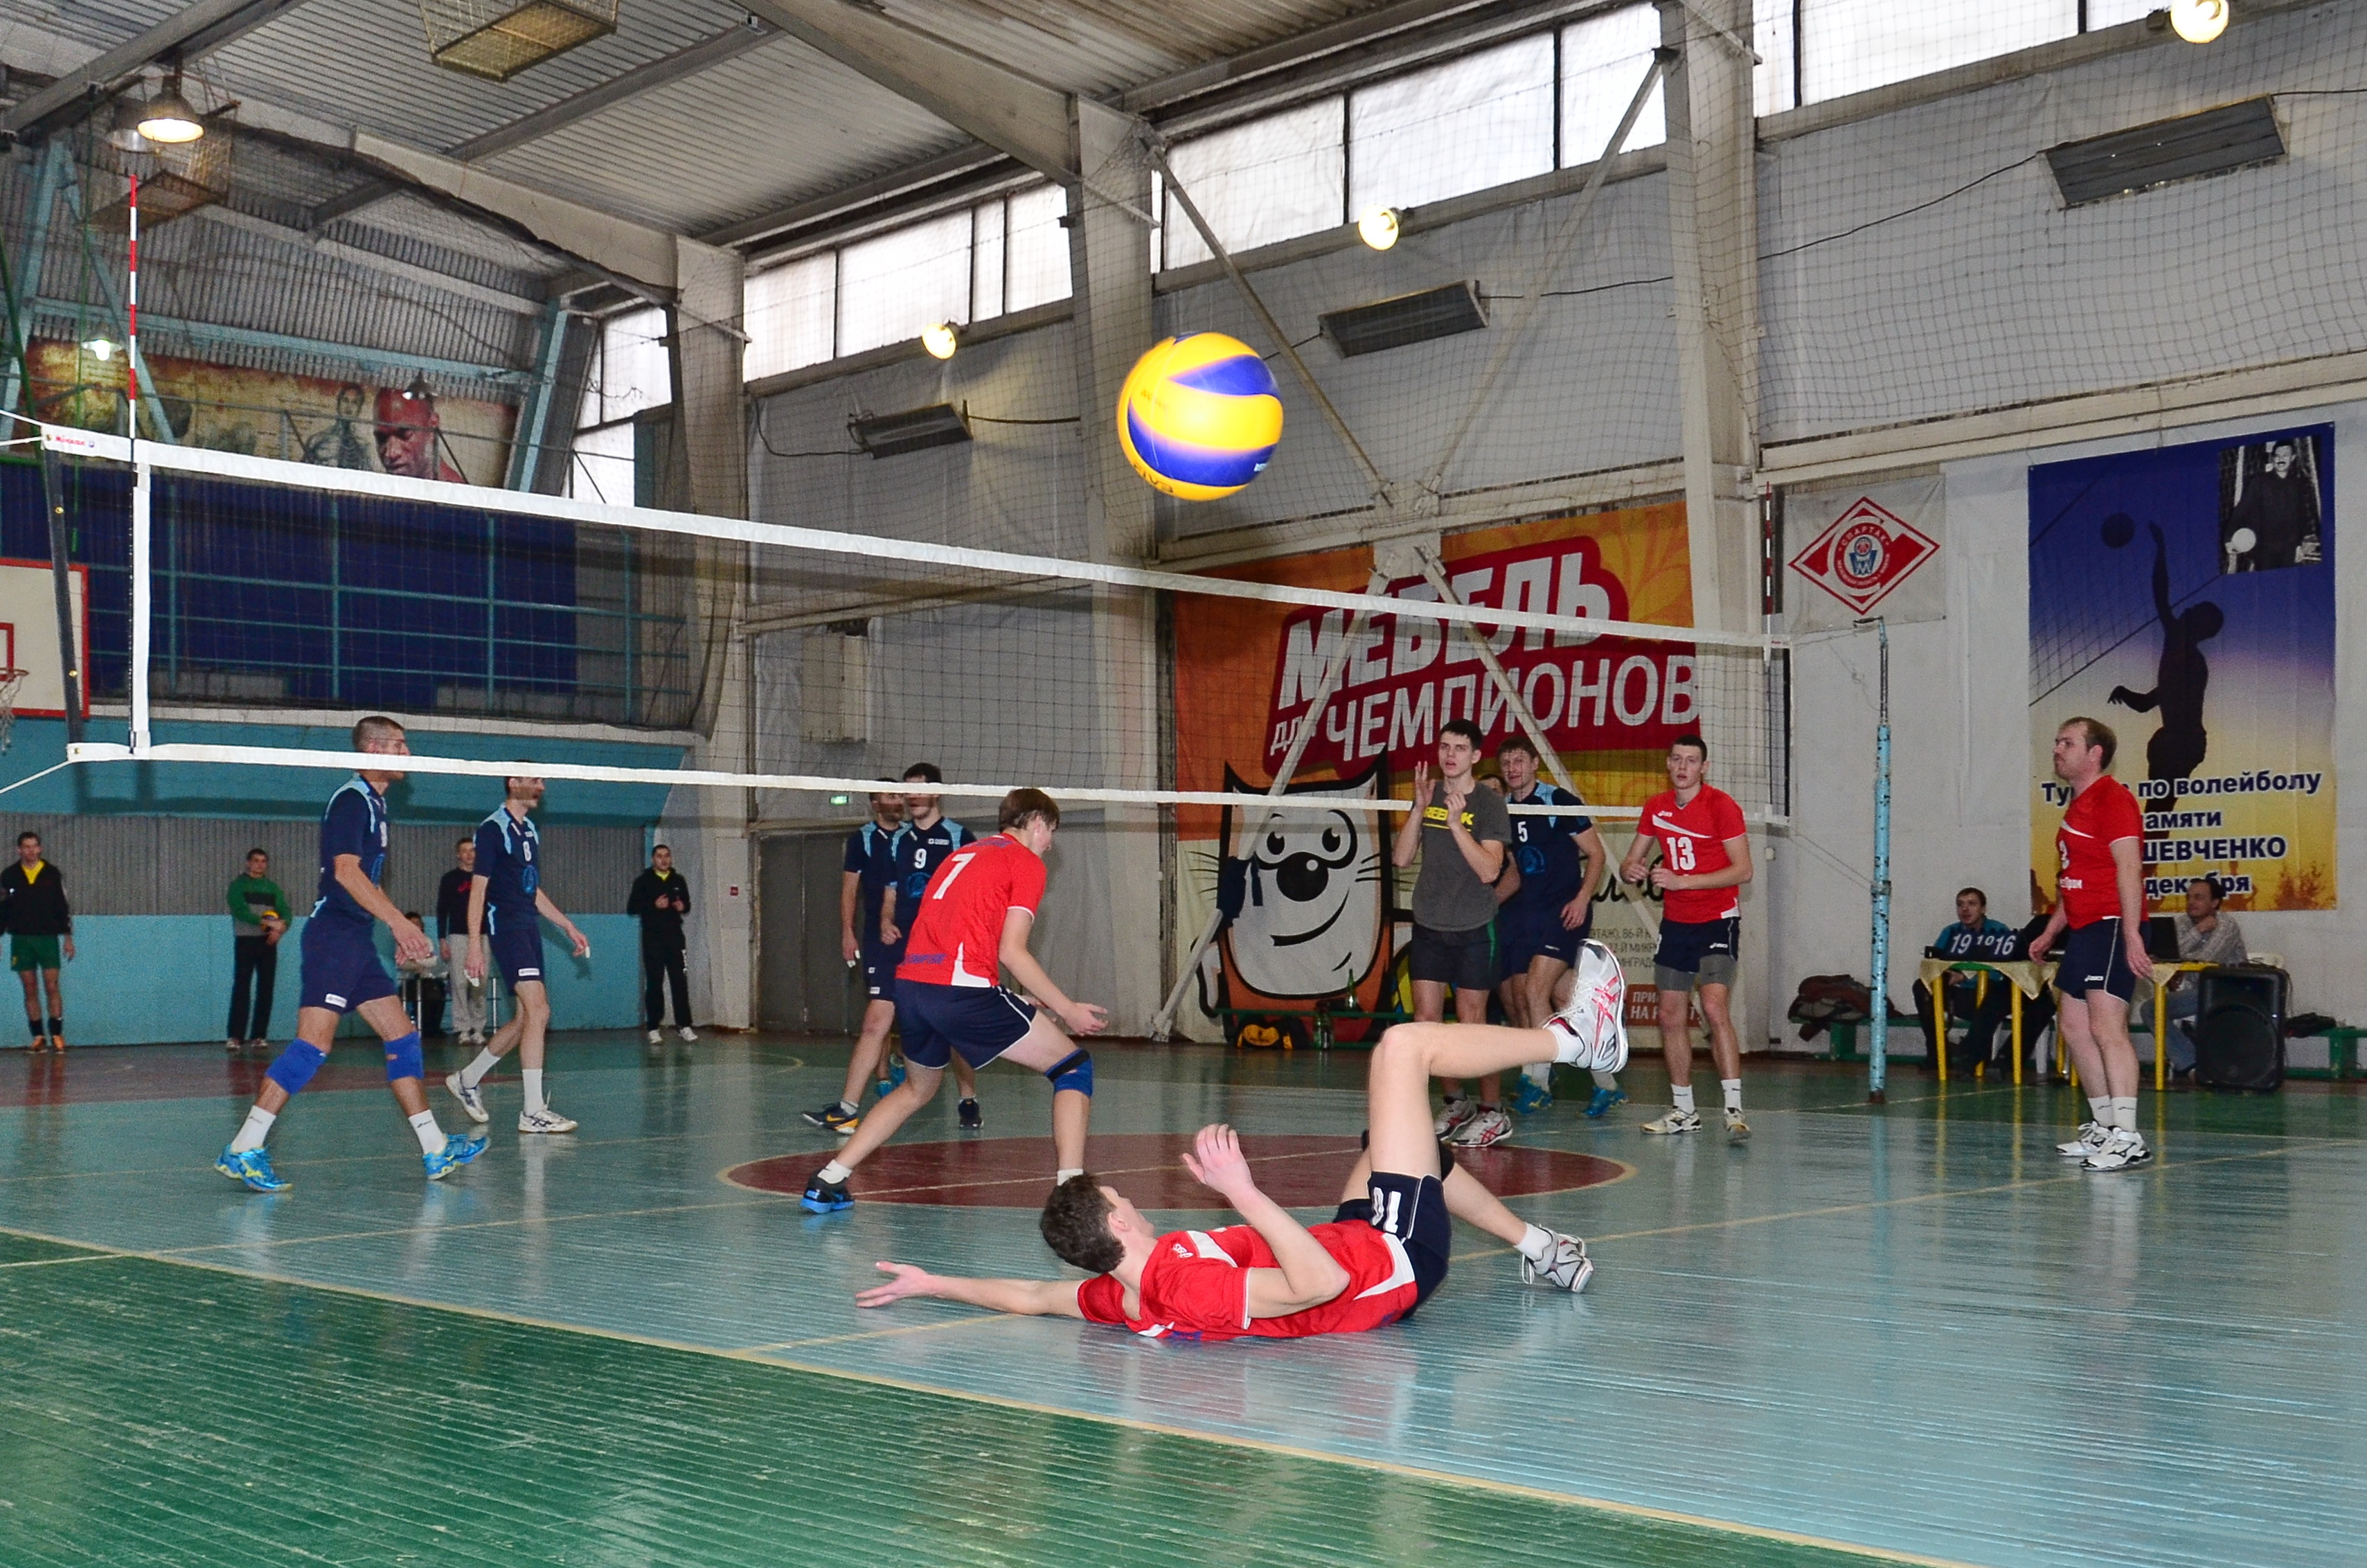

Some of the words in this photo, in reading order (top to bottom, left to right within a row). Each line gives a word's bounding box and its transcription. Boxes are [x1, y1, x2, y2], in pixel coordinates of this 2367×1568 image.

[1278, 552, 1610, 710] МЕБЕЛЬ
[1326, 654, 1701, 761] ЧЕМПИОНОВ
[2138, 781, 2168, 796] по
[2176, 770, 2321, 794] волейболу
[1423, 806, 1474, 826] REEK
[2142, 812, 2222, 829] амяти
[1517, 821, 1528, 842] 5
[914, 848, 927, 869] 9
[1666, 836, 1696, 871] 13
[932, 853, 976, 900] 7
[1950, 934, 1972, 954] 19
[1994, 935, 2016, 955] 16
